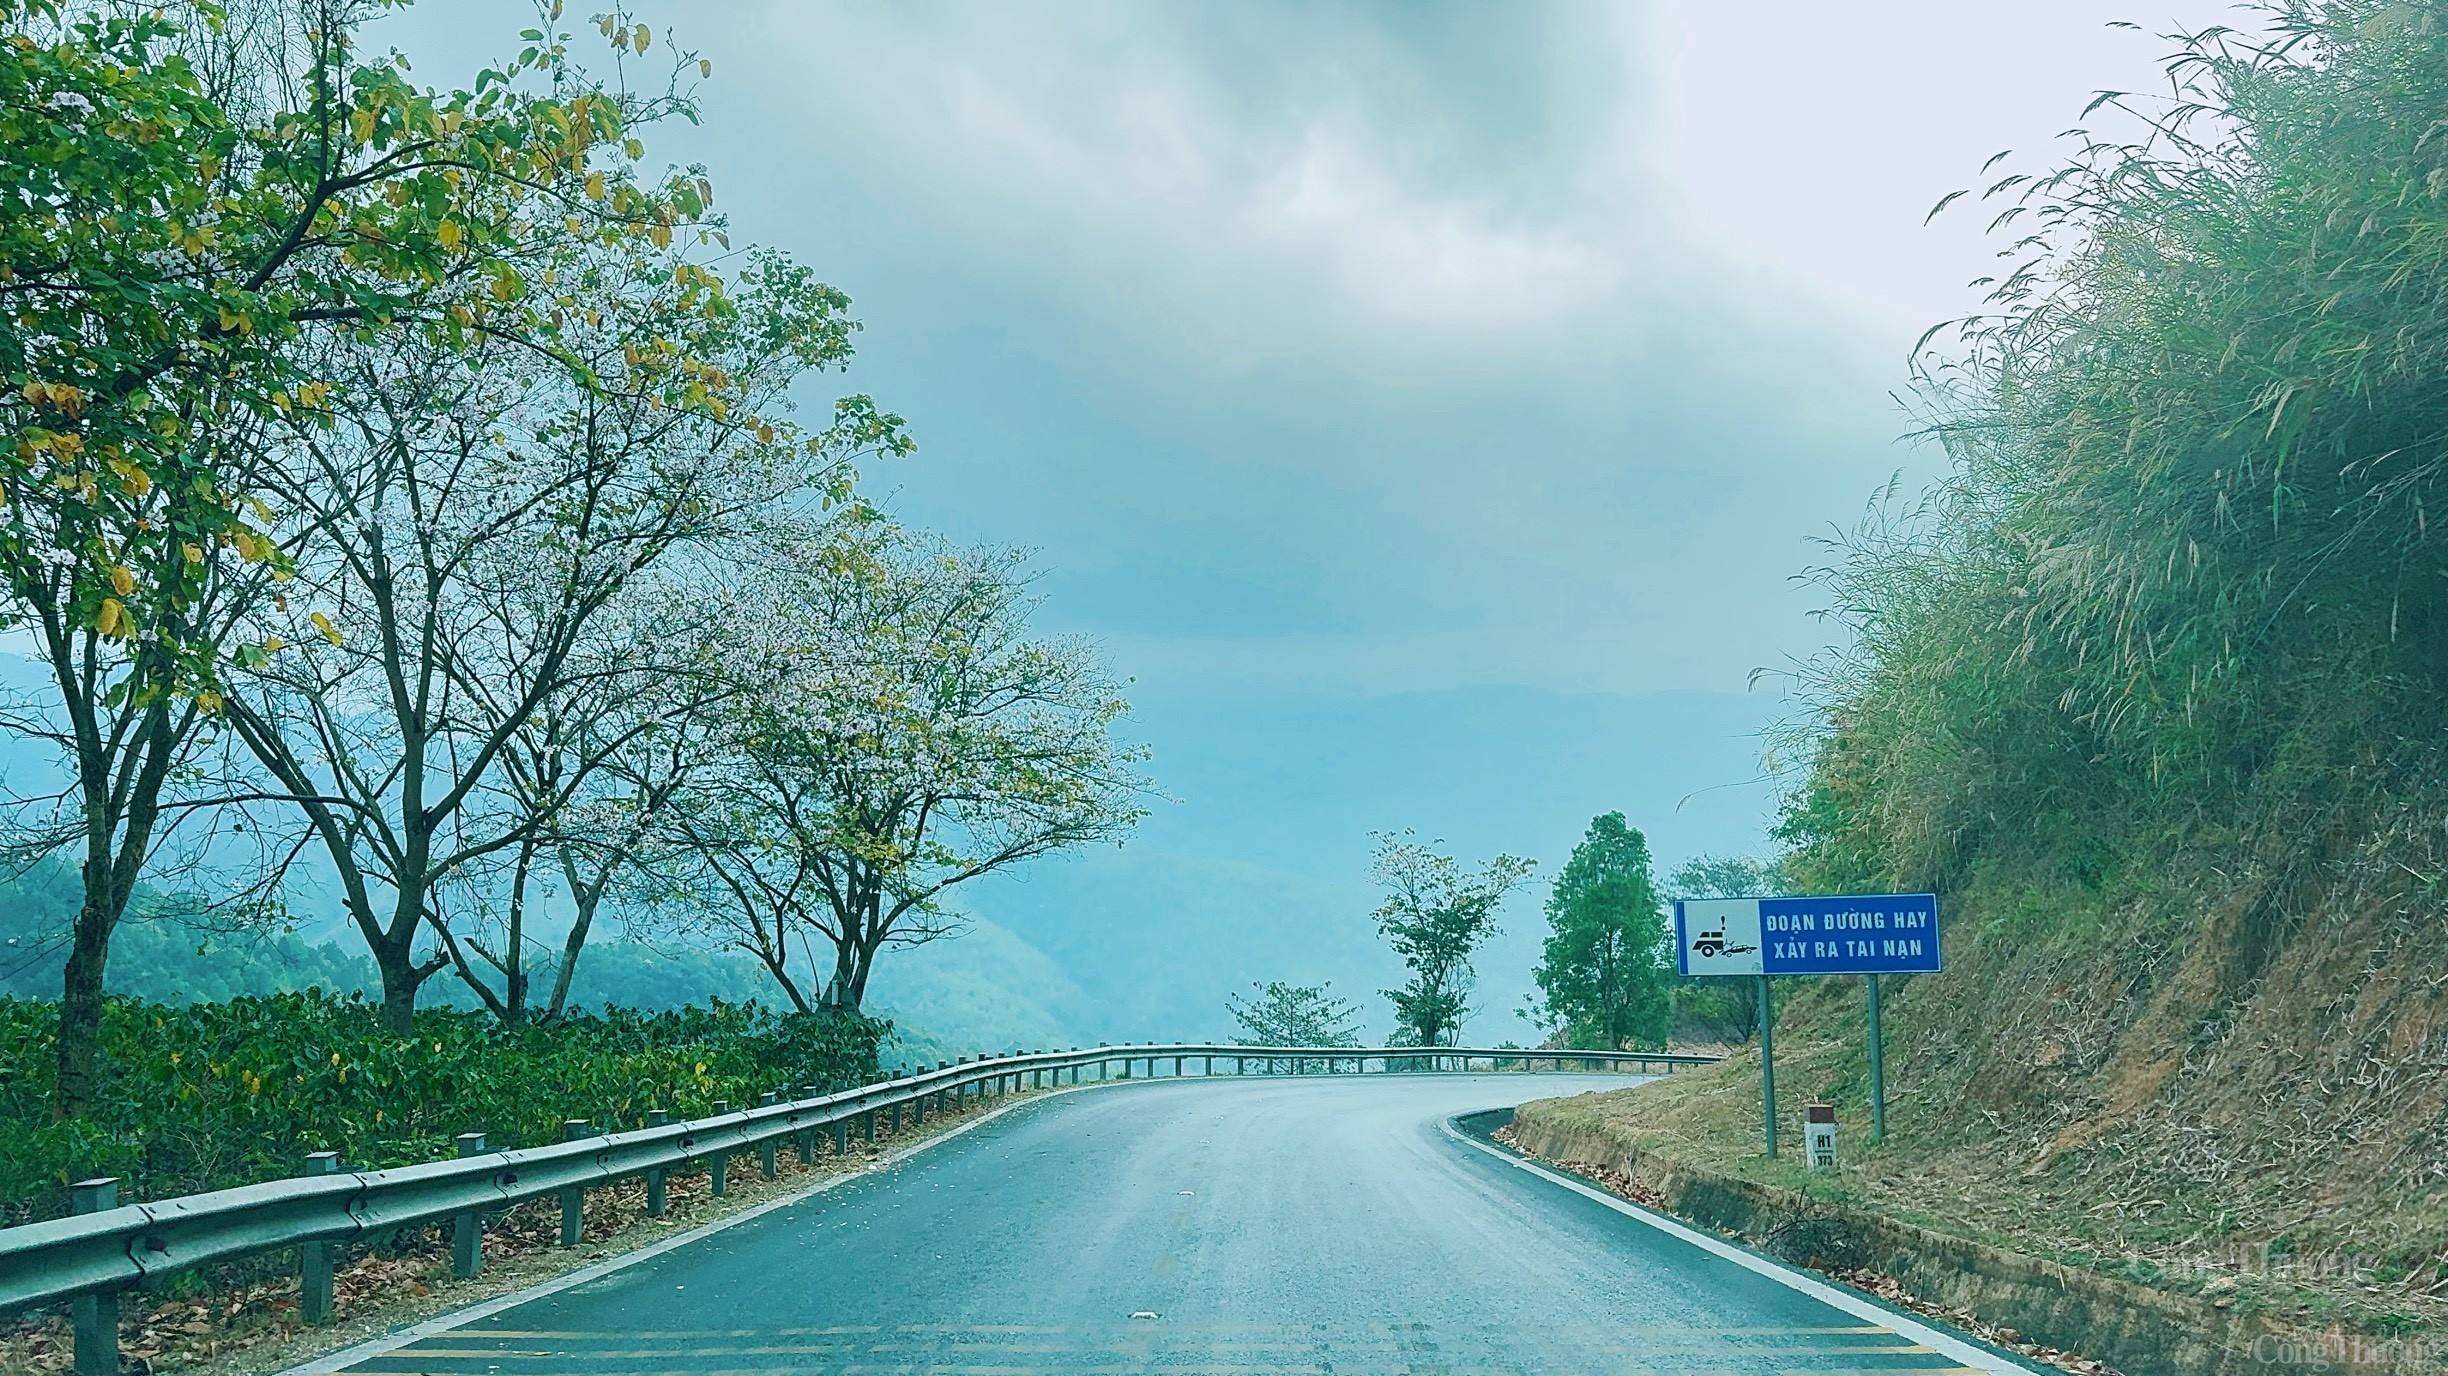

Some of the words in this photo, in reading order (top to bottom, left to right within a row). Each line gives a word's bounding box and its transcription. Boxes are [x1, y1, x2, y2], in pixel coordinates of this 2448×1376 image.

[1766, 914, 1814, 934] ĐOẠN
[1823, 908, 1885, 930] ĐƯỜNG
[1894, 911, 1927, 928] HAY
[1774, 936, 1807, 958] XẢY
[1815, 941, 1839, 958] RA
[1846, 940, 1876, 957] TAI
[1884, 939, 1922, 959] NẠN
[1817, 1134, 1831, 1148] H1
